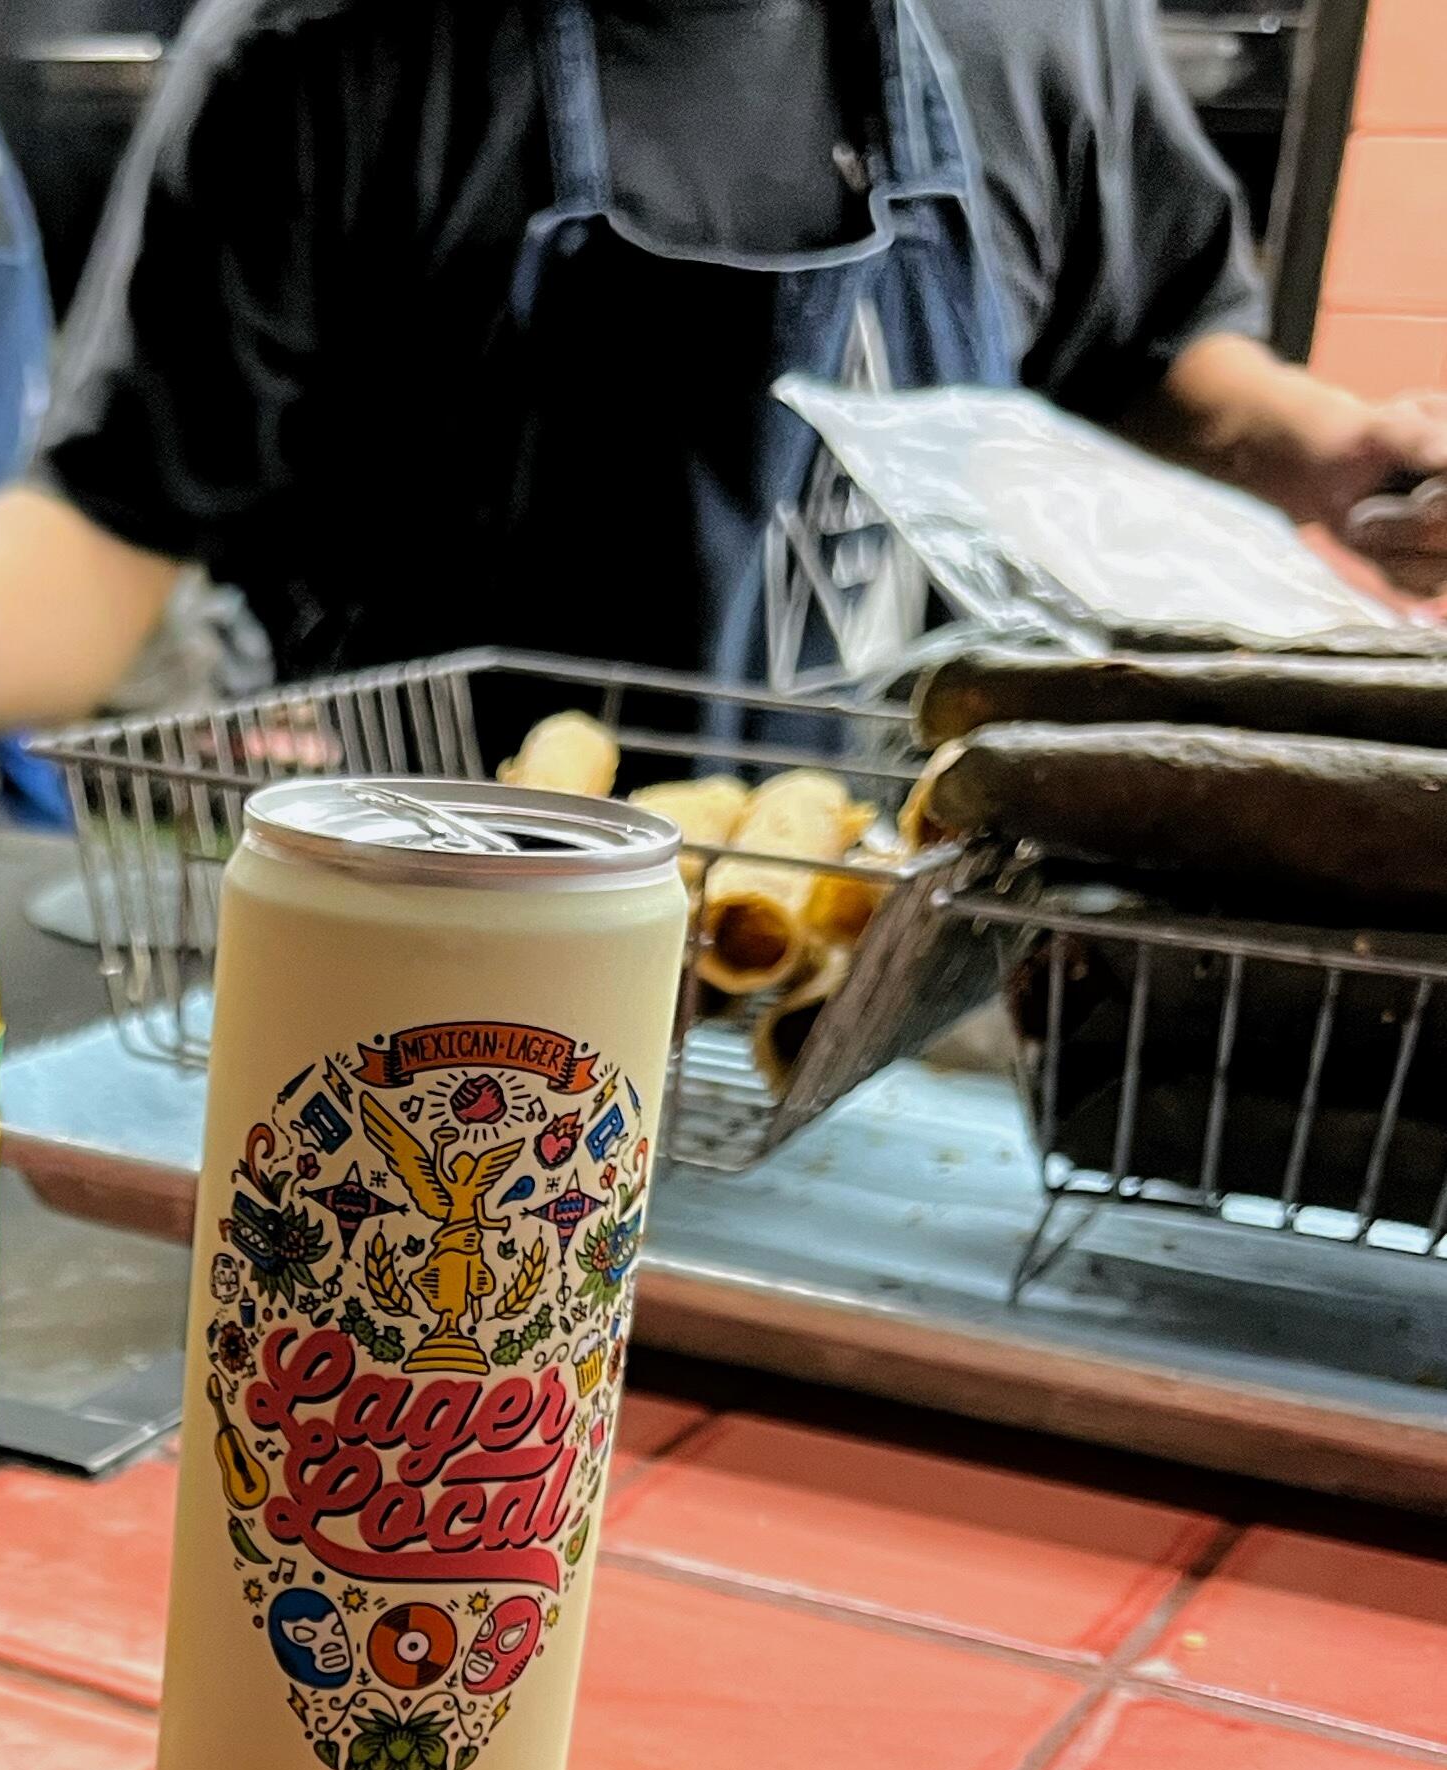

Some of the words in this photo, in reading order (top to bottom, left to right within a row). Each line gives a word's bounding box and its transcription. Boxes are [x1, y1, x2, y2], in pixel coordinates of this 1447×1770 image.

[403, 1030, 498, 1067] MEXICAN
[505, 1032, 567, 1073] LAGER
[244, 1327, 578, 1487] Lager
[265, 1440, 578, 1593] Local
